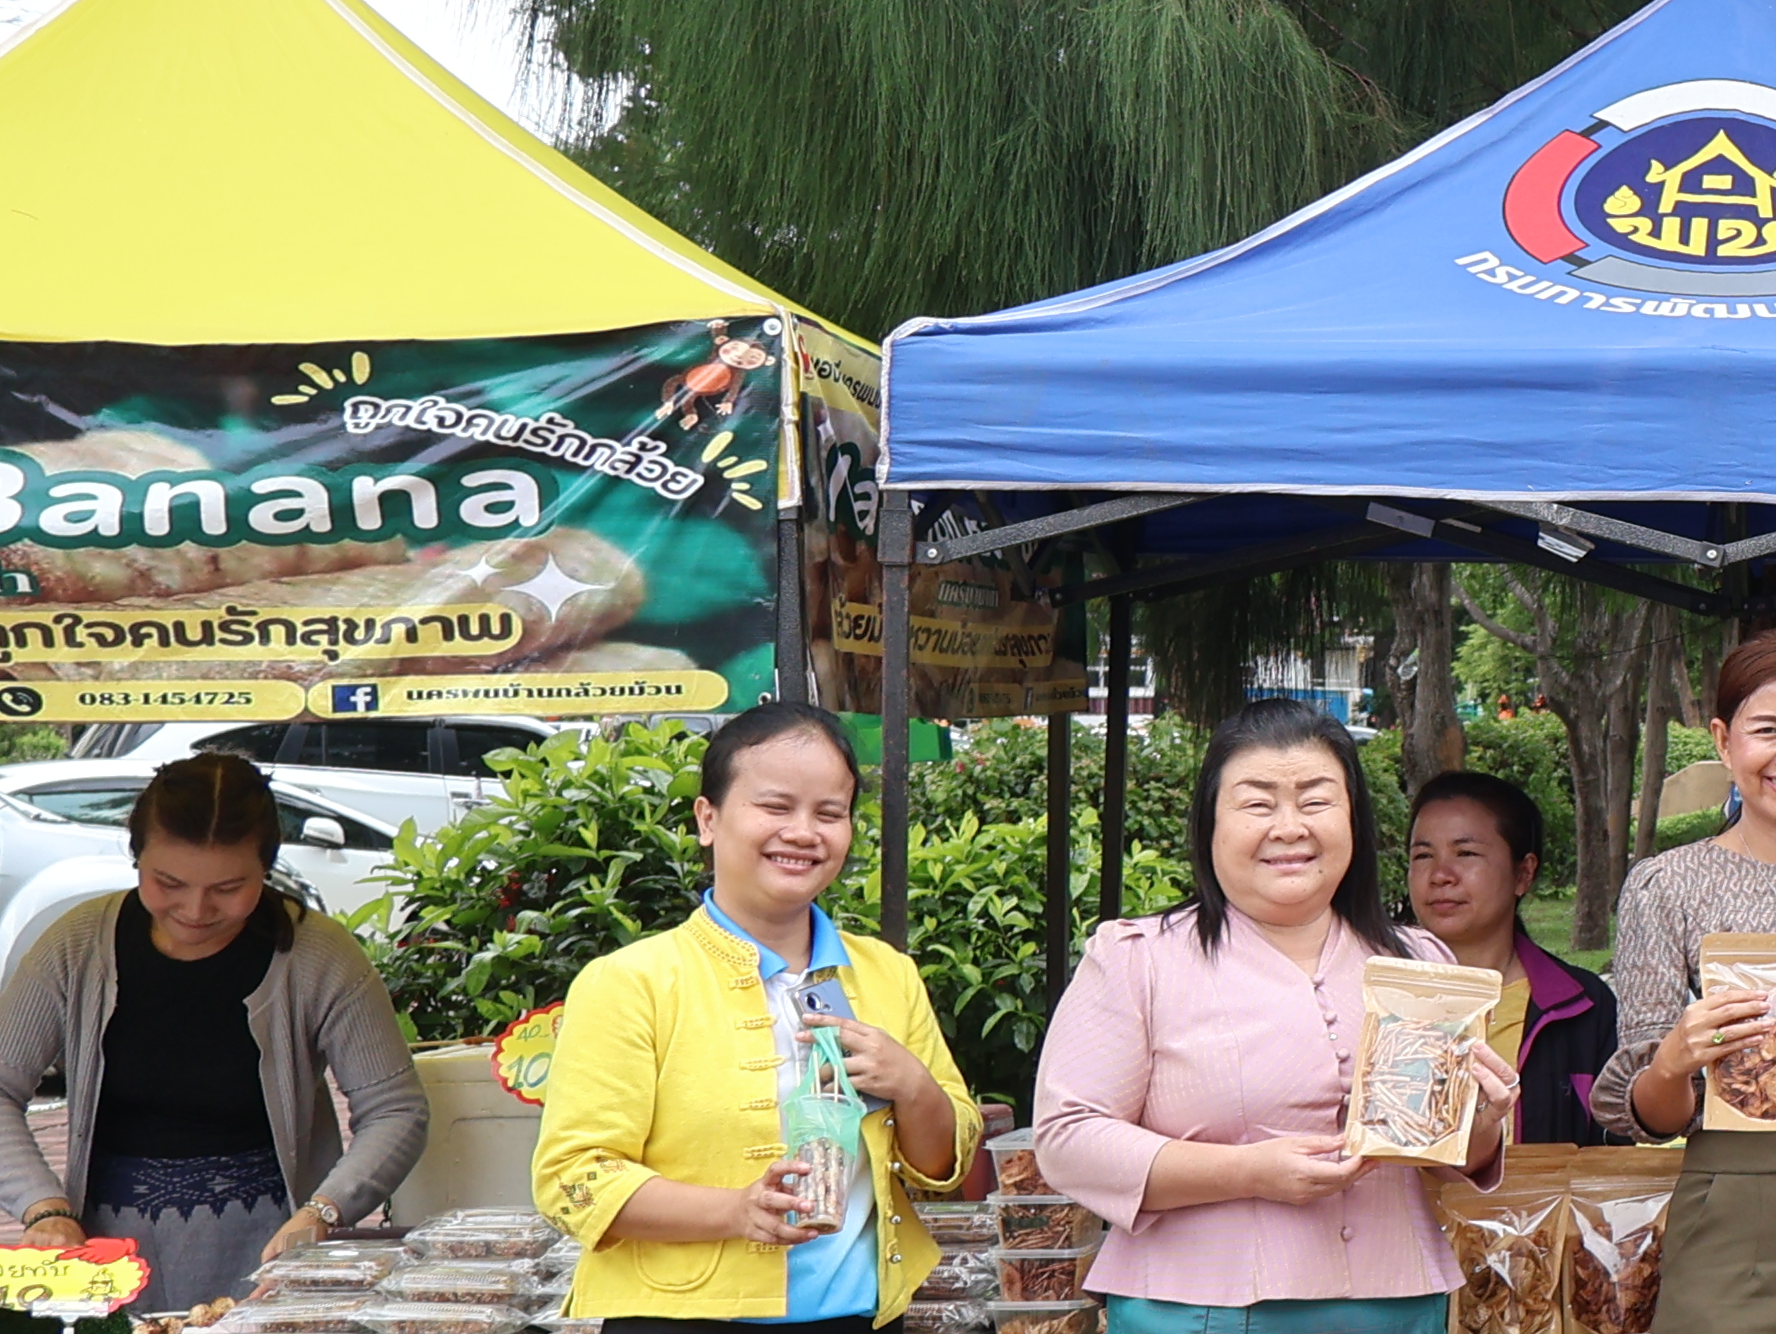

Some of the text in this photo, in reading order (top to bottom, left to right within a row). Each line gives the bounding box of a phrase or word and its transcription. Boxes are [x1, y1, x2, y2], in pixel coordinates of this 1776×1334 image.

[345, 397, 703, 499] ถูกใจคนรักกล้วย
[78, 691, 253, 706] 083-1454725
